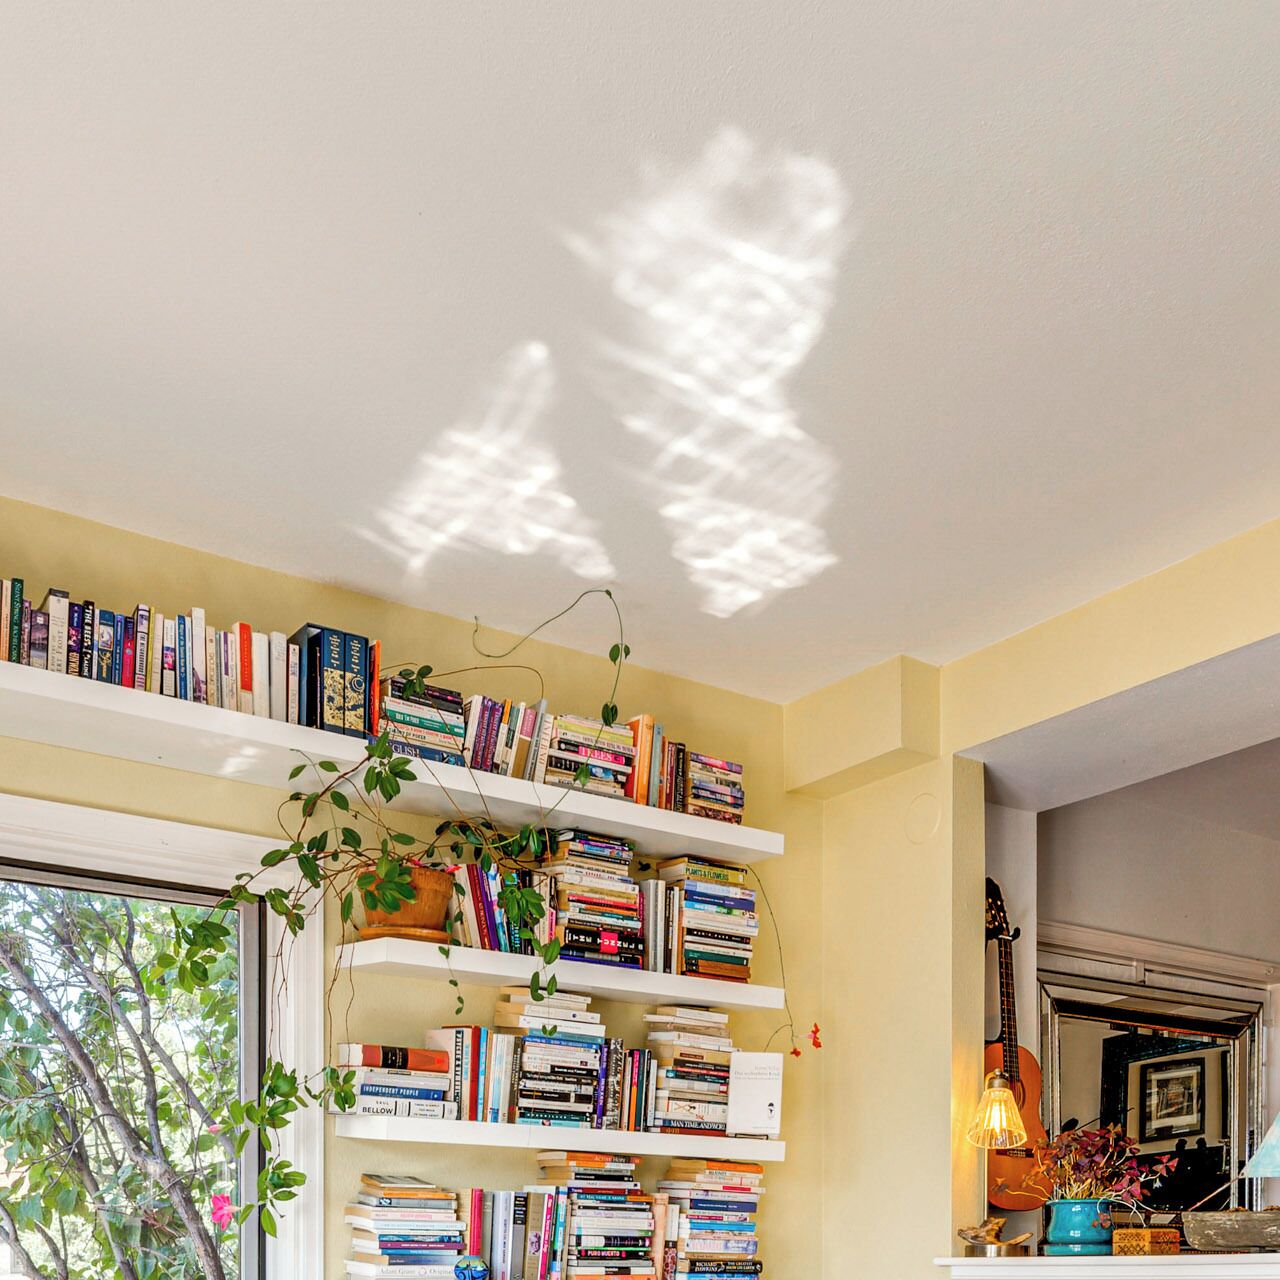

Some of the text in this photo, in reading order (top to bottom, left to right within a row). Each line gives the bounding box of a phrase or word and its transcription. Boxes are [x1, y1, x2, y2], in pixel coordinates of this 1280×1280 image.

[84, 608, 93, 645] THE BEES
[538, 716, 552, 767] INFERNO
[580, 746, 613, 761] TREES
[686, 867, 703, 876] PLANTS
[706, 871, 729, 881] FLOWERS
[572, 934, 635, 949] THE TUNNEL
[363, 1085, 419, 1097] INDEPENDENT PEOPLE
[362, 1106, 394, 1115] BELLOW
[670, 1120, 683, 1128] MAN
